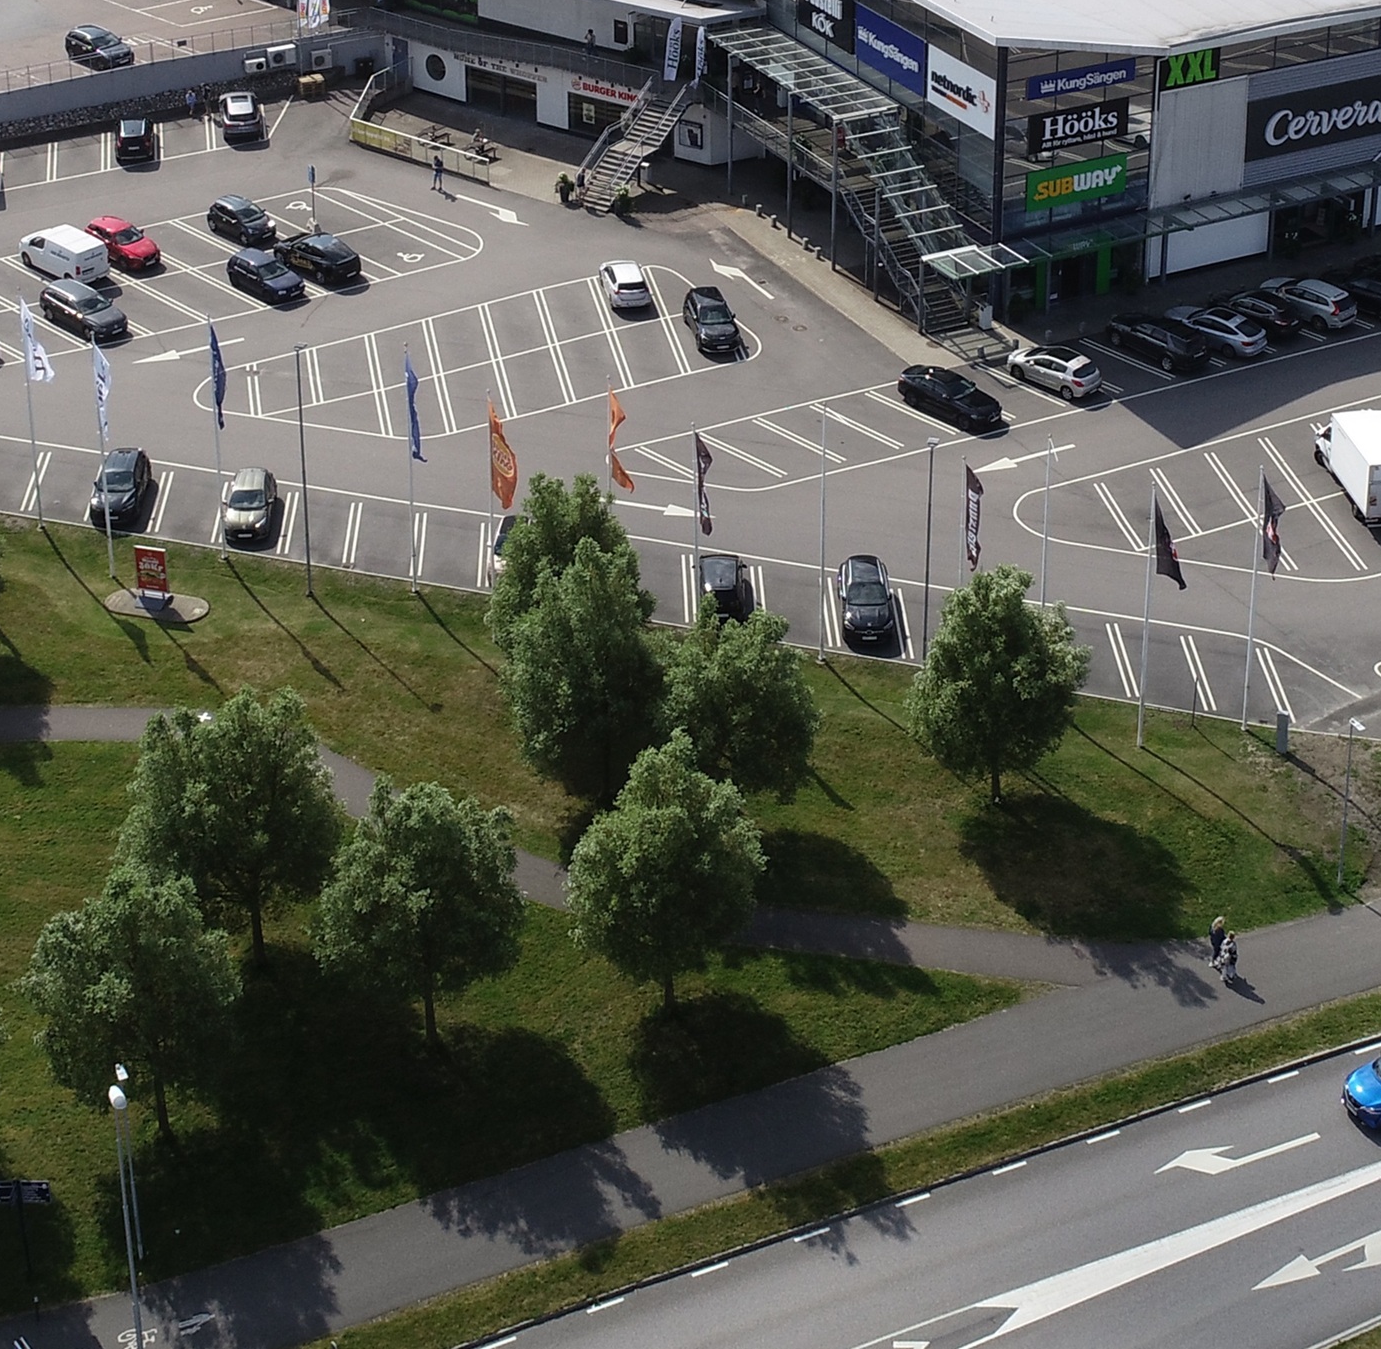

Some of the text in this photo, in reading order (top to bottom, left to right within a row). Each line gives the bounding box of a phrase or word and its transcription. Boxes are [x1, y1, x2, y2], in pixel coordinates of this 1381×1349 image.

[812, 11, 835, 38] KÖK
[667, 28, 681, 70] Hööks
[868, 31, 919, 73] KungSängen
[1057, 69, 1127, 92] KungSängen
[1166, 49, 1217, 87] XXL
[582, 81, 618, 100] BURGER
[931, 70, 977, 107] netnordic
[1042, 107, 1118, 141] Hööks
[1033, 164, 1123, 201] SUBWAY
